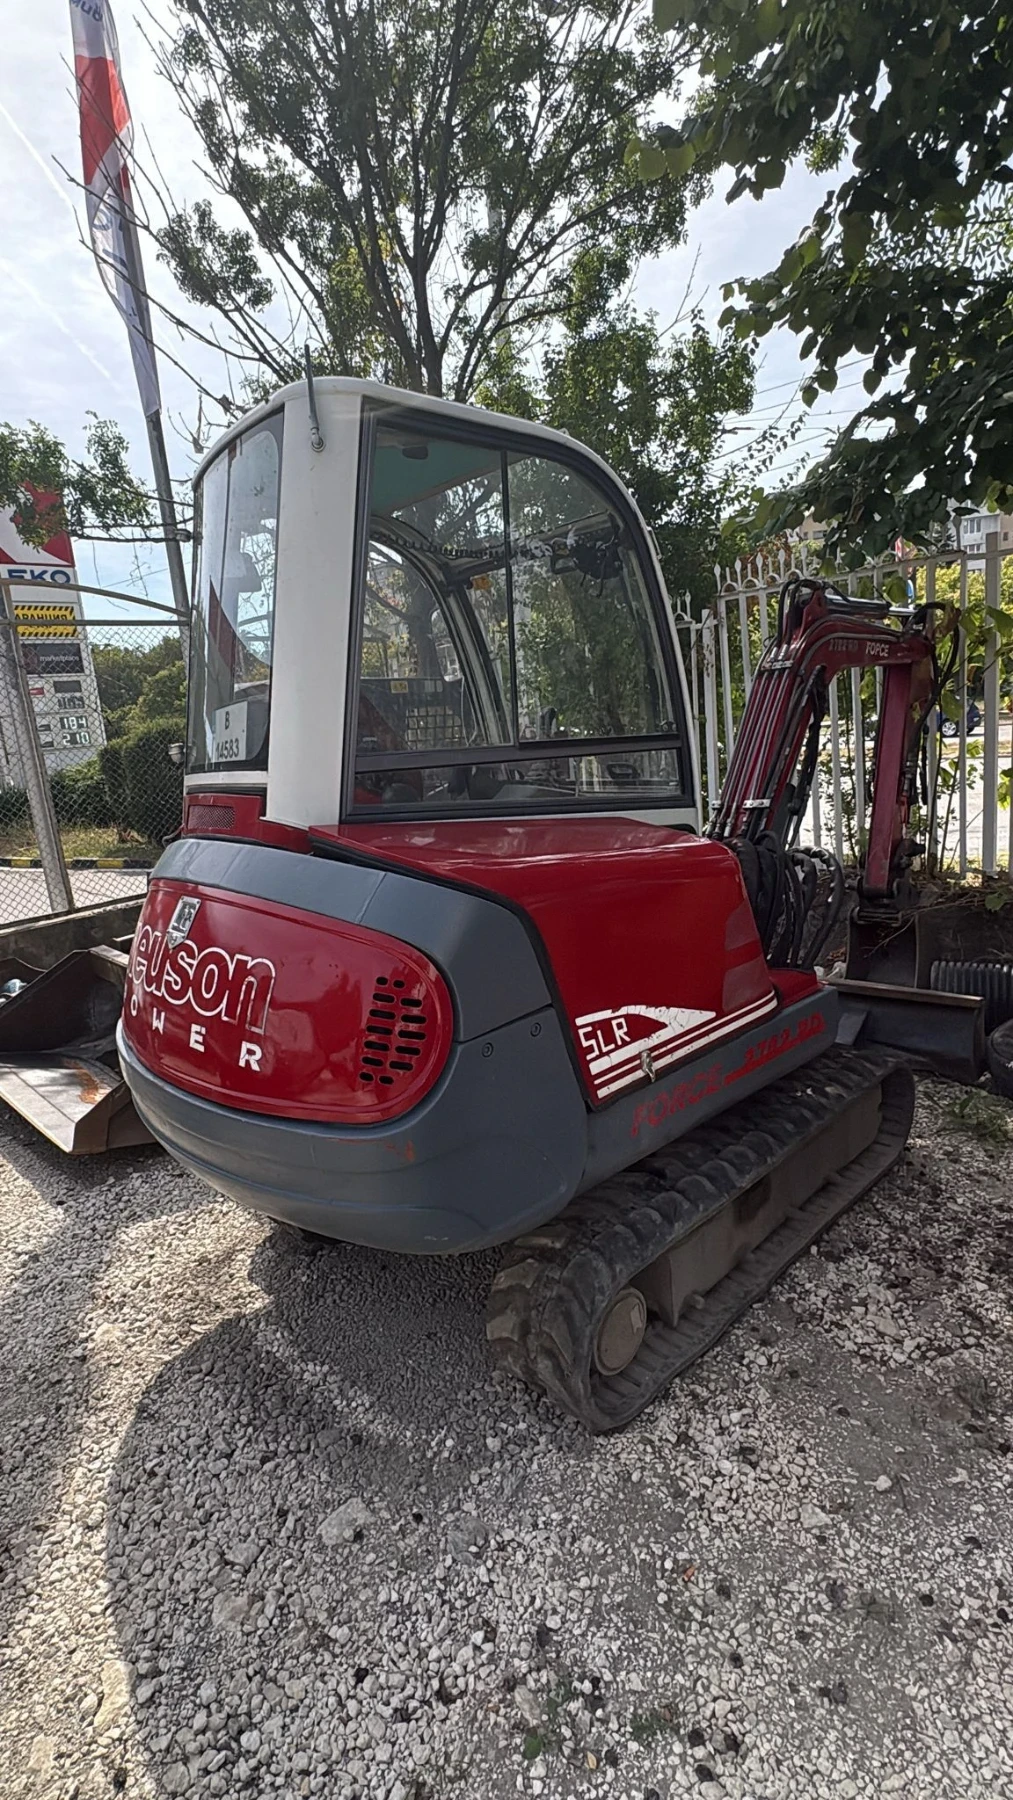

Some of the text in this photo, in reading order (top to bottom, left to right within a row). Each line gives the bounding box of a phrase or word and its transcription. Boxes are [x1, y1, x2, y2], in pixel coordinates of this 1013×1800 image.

[7, 568, 71, 584] EKO
[865, 641, 890, 657] FORCE
[215, 738, 240, 760] 14583
[126, 920, 277, 1034] euson
[124, 982, 263, 1072] OWER
[578, 1017, 631, 1061] SLR
[631, 1063, 723, 1138] FORCE
